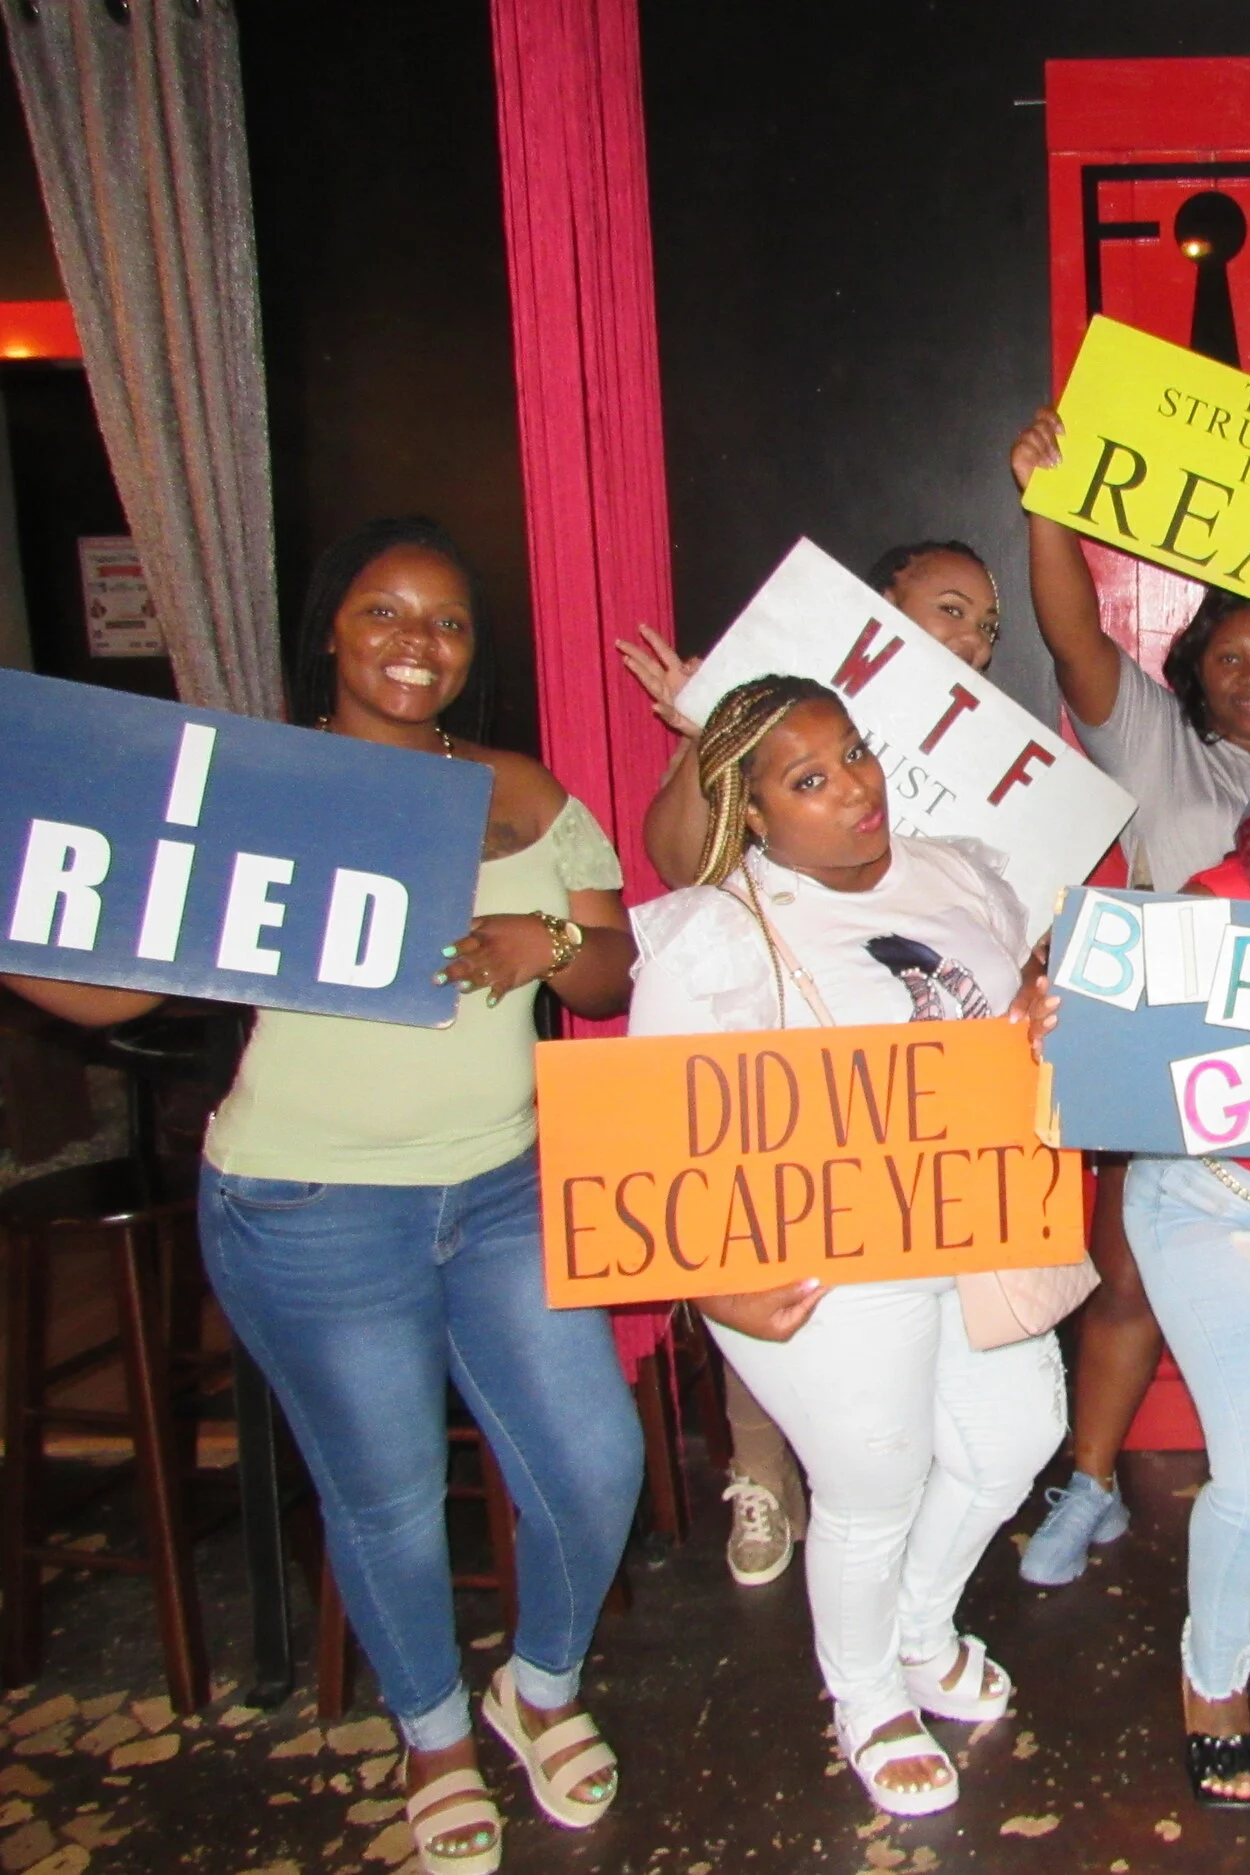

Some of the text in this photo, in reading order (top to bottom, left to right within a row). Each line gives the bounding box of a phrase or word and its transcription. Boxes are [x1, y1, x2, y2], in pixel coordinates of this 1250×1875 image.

[164, 722, 217, 828] I
[686, 1041, 948, 1158] DID WE
[562, 1142, 1061, 1280] ESCAPE YET?
